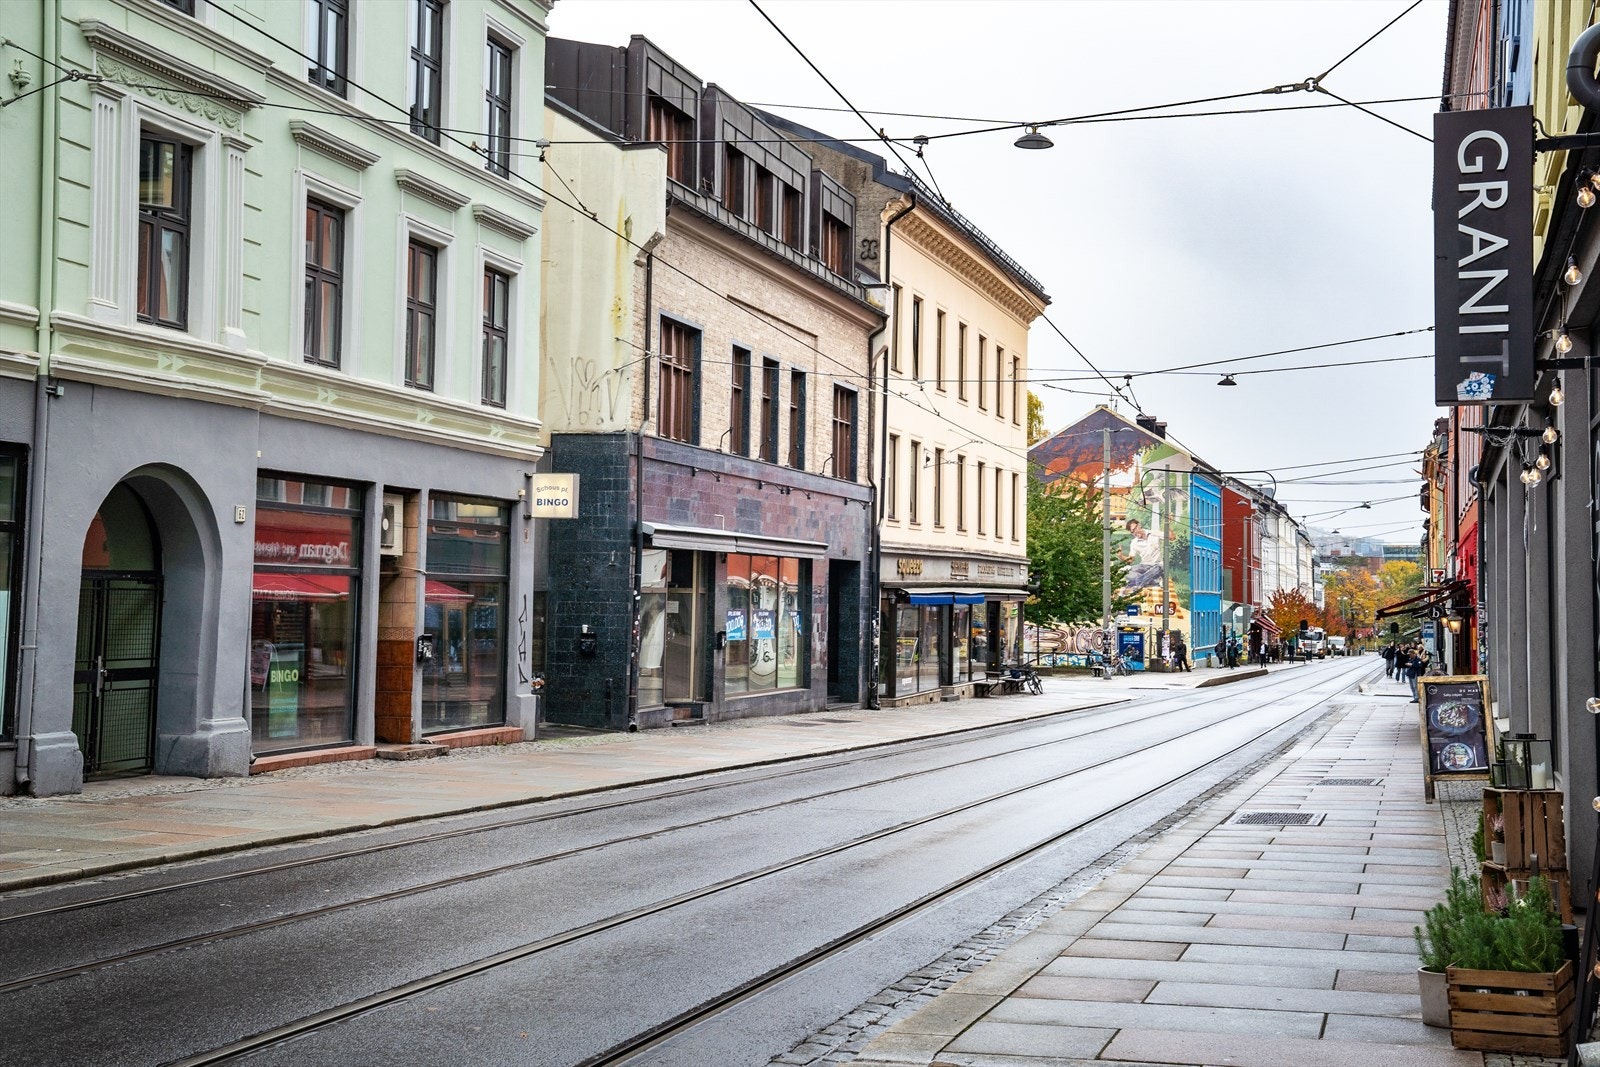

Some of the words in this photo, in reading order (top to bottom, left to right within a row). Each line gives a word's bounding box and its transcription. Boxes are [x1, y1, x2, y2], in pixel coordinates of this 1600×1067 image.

[1457, 129, 1509, 377] GRANIT
[536, 498, 569, 506] BINGO
[270, 669, 299, 683] BINGO
